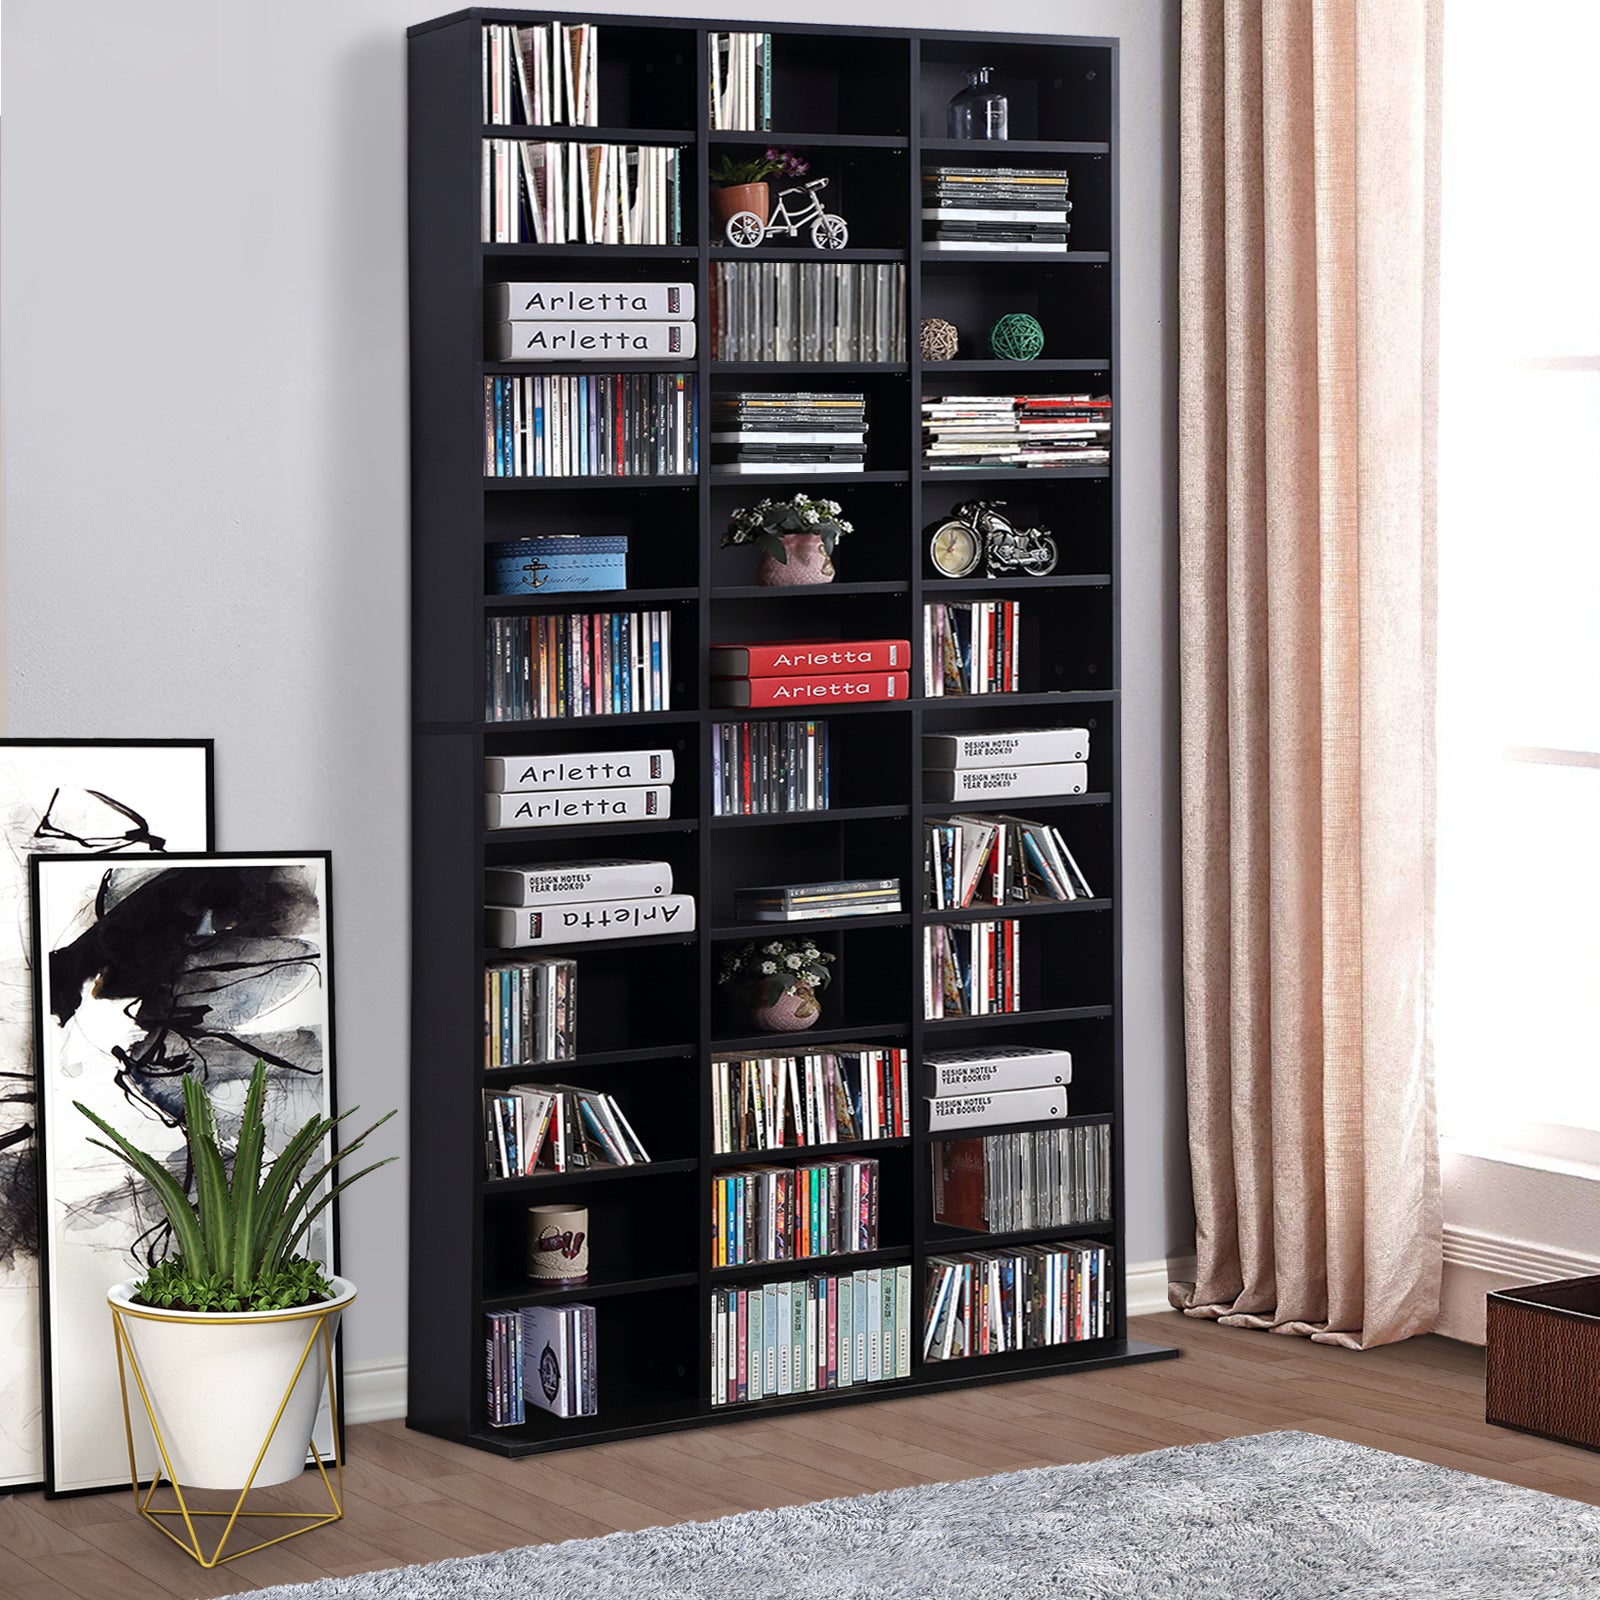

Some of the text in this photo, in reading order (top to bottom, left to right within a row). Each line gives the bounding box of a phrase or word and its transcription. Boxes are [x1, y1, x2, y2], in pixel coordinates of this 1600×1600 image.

[525, 291, 648, 311] Arletta
[526, 329, 648, 350] Arletta
[773, 651, 871, 667] Arletta
[773, 682, 870, 699] Arletta
[964, 739, 1020, 751] DESIGN HOTELS
[964, 748, 983, 757] YEAR
[519, 763, 631, 784] Arletta
[962, 772, 1018, 783] DESIGN HOTELS
[962, 780, 981, 790] YEAR
[514, 799, 628, 820] Arletta
[529, 873, 592, 886] DESIGN HOTELS
[529, 884, 550, 893] YEAR
[563, 905, 681, 928] Arletta
[941, 1065, 998, 1078] DESIGN HOTELS
[941, 1075, 961, 1085] YEAR
[935, 1096, 992, 1109] DESIGN HOTELS
[935, 1106, 955, 1117] YEAR
